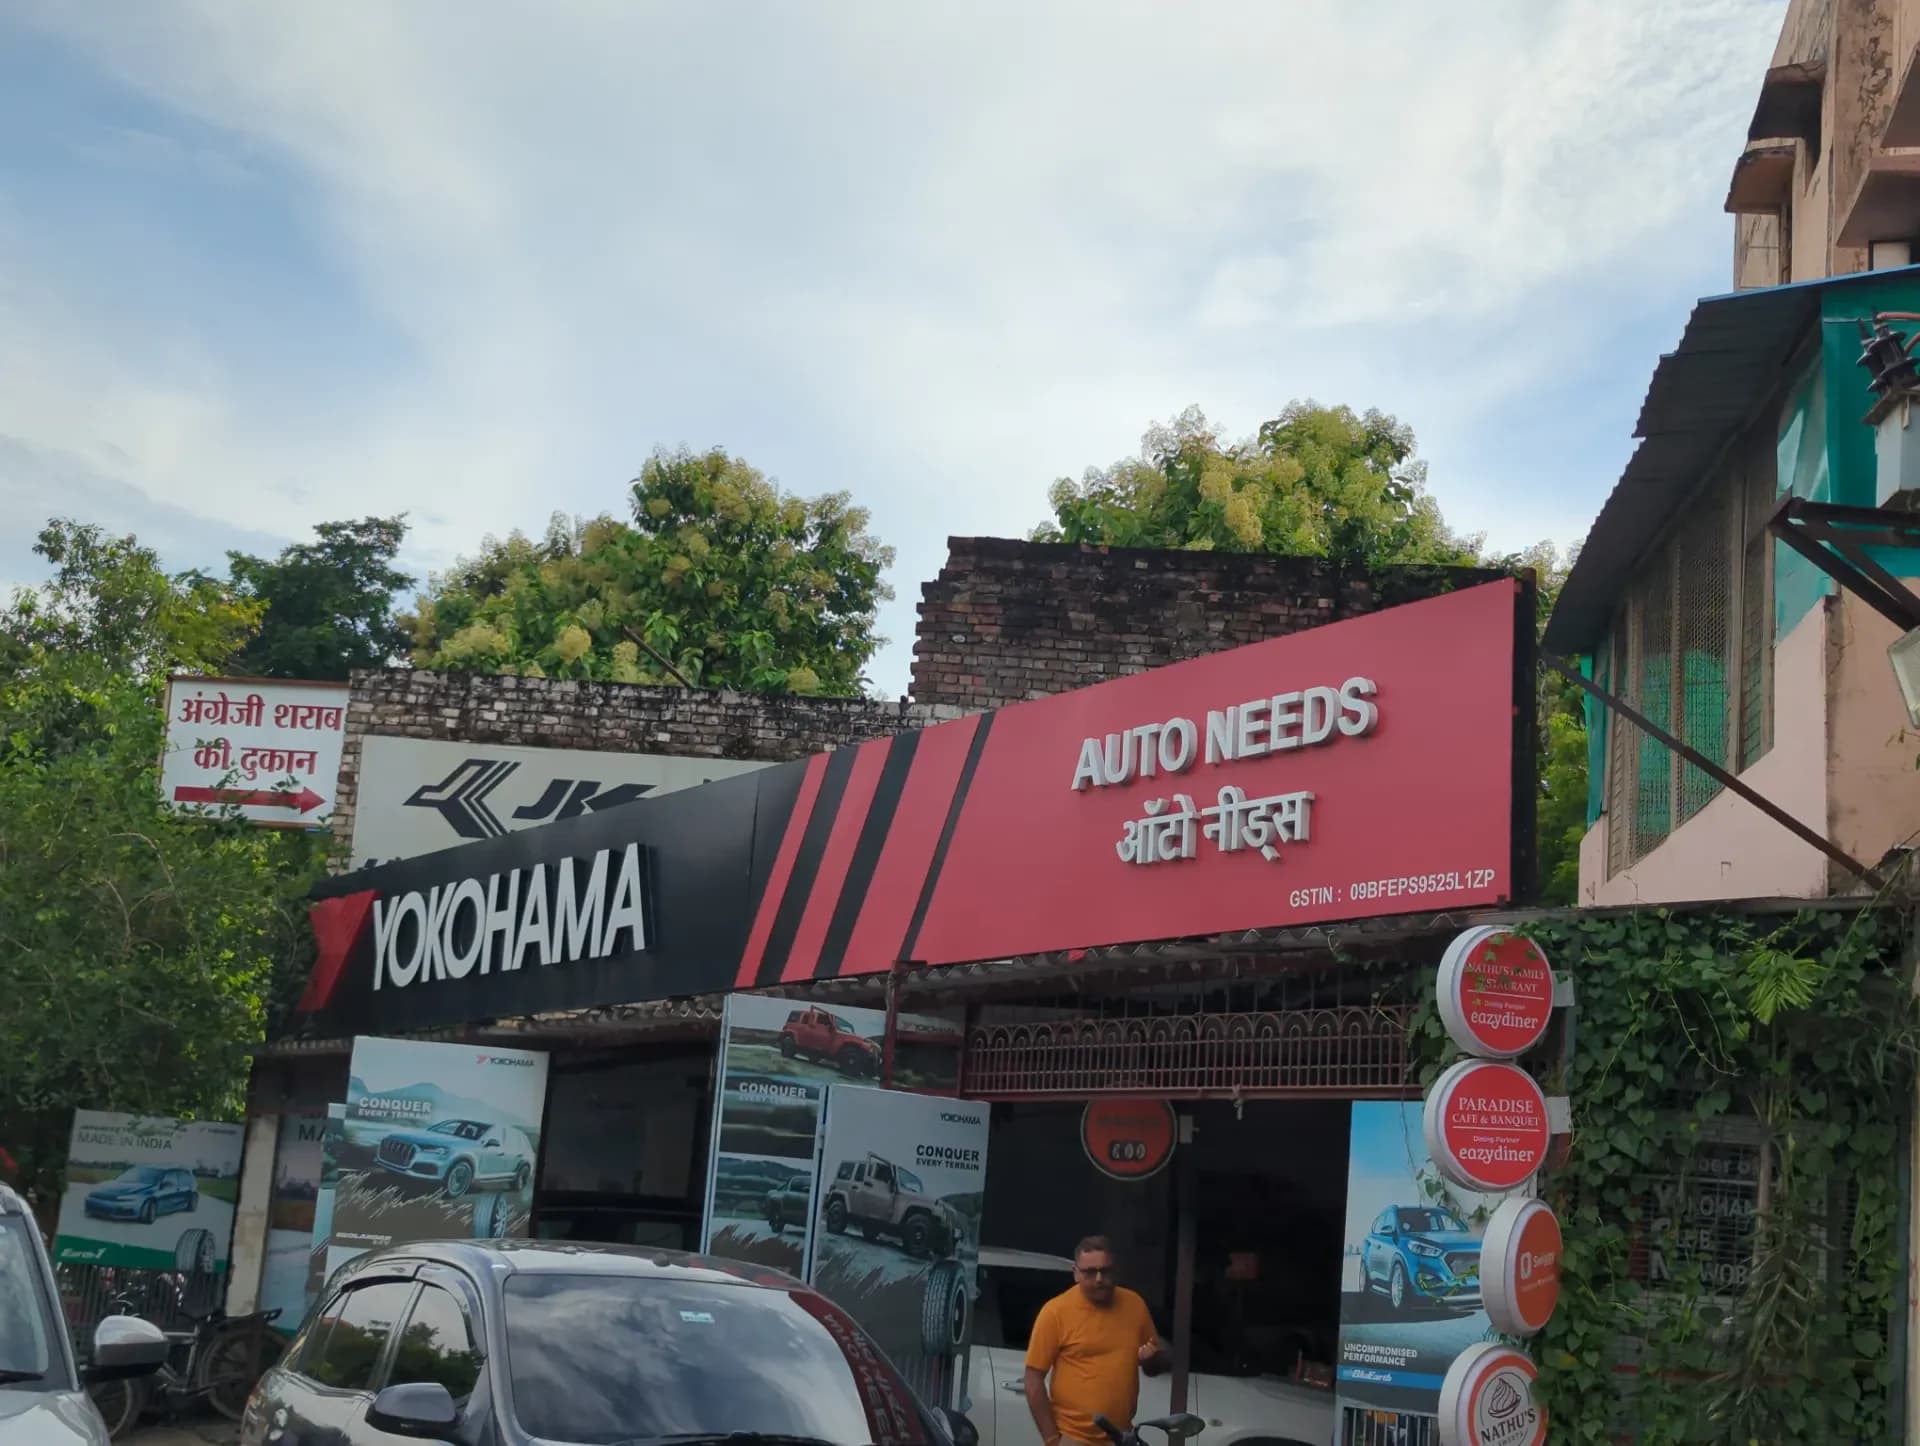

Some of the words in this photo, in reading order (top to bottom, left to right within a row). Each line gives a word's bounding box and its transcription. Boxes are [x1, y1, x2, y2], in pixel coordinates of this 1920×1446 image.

[178, 691, 266, 727] अंग्रेजी
[274, 703, 344, 731] शराब
[1071, 717, 1198, 791] AUTO
[1205, 676, 1378, 765] NEEDS
[240, 747, 318, 780] दुकान
[1115, 794, 1200, 865] ऑटो
[1201, 785, 1316, 861] नीड्स
[1289, 885, 1334, 907] GSTIN
[1350, 868, 1496, 901] 09BFEPS9525L1ZP
[373, 841, 646, 991] YOKOHAMA
[1471, 1011, 1538, 1029] eazydiner
[740, 1082, 807, 1098] CONQUER
[359, 1096, 431, 1112] CONQUER
[1459, 1097, 1534, 1113] PARADISE
[1452, 1113, 1478, 1123] CAFE
[1480, 1116, 1489, 1124] &
[1491, 1114, 1539, 1127] BANQUET
[78, 1132, 113, 1145] MADE
[120, 1135, 133, 1147] IN
[137, 1137, 172, 1150] INDIA
[916, 1144, 979, 1161] CONQUER
[1459, 1145, 1534, 1164] eazydiner
[916, 1158, 943, 1167] EVERY
[1343, 1352, 1406, 1366] PERFORMANCE
[1344, 1343, 1418, 1358] UNCOMPROMISED
[1481, 1408, 1536, 1444] NATHU'S
